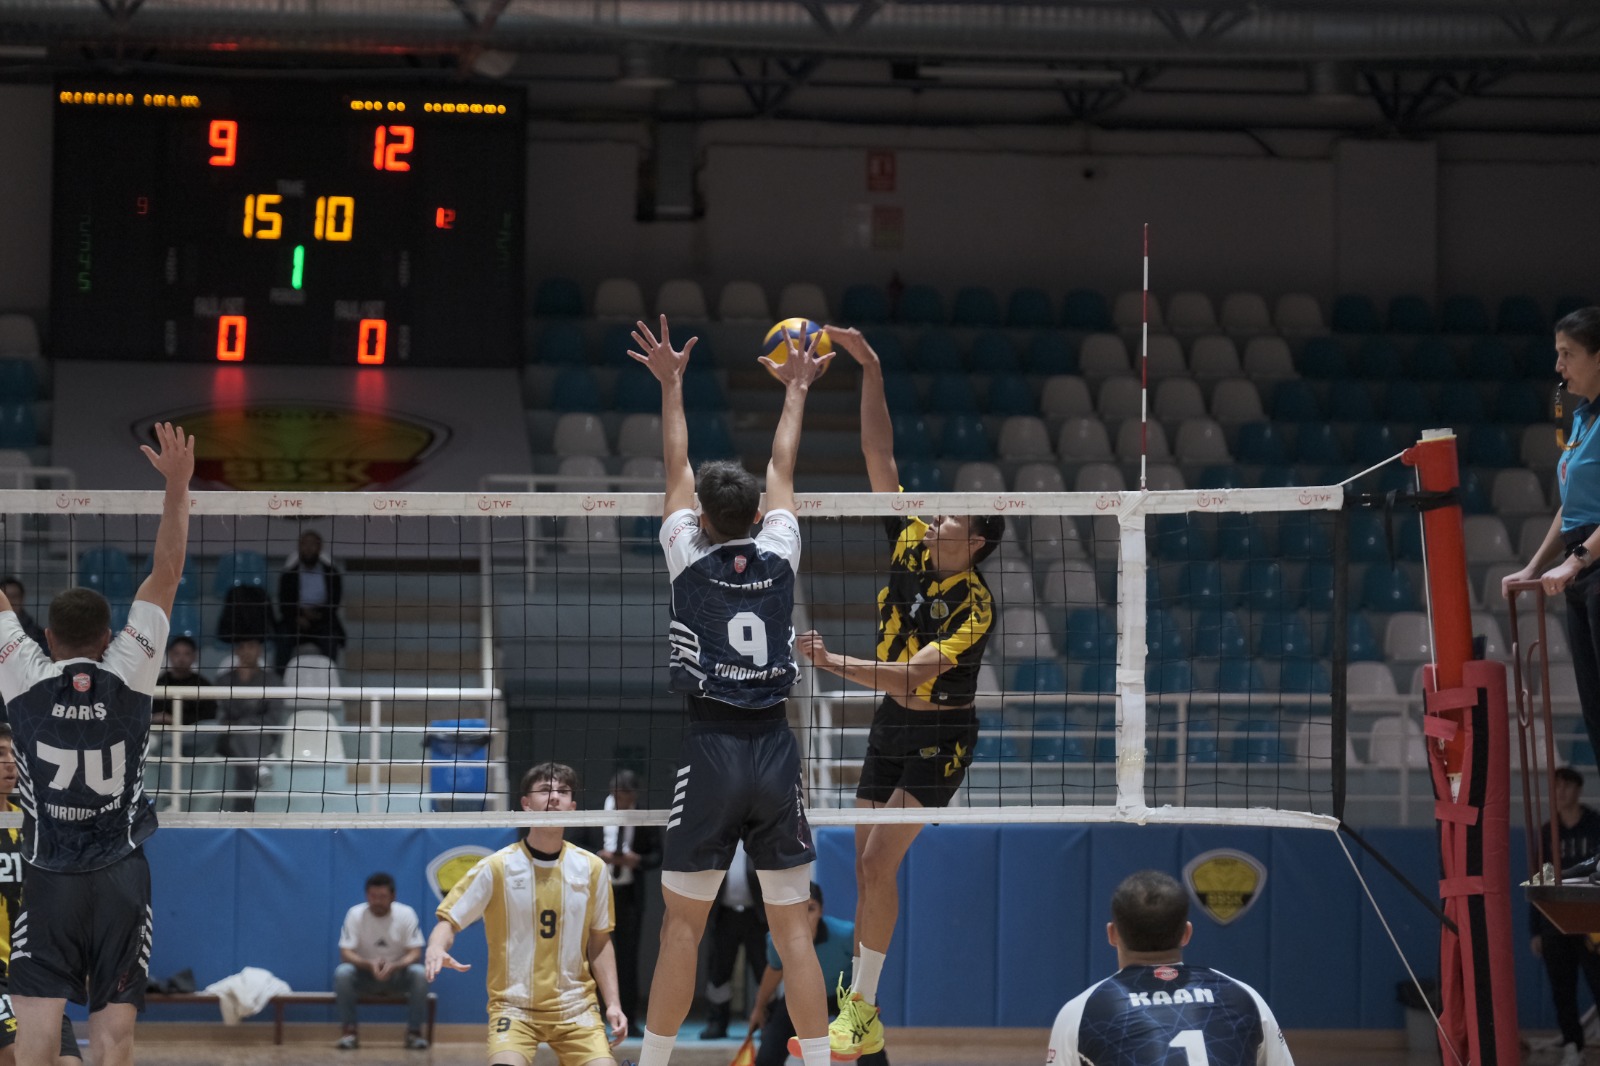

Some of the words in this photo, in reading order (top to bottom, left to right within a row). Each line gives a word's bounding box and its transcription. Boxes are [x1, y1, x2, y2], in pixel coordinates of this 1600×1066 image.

[208, 120, 238, 166] 9
[373, 126, 414, 171] 12
[137, 197, 148, 214] 9
[243, 194, 282, 239] 15
[314, 196, 354, 241] 10
[292, 245, 304, 289] 1
[217, 316, 247, 361] 0
[358, 319, 387, 364] 0
[283, 499, 303, 508] TVF
[389, 500, 407, 508] TVF
[493, 500, 512, 509] TVF
[597, 500, 616, 509] TVF
[803, 500, 822, 509] TVF
[906, 500, 925, 509] TVF
[1212, 497, 1226, 505] TV
[727, 611, 768, 667] 9
[51, 702, 108, 721] BARIŞ
[0, 852, 22, 883] 21
[540, 910, 557, 939] 9
[1129, 988, 1215, 1006] KAAN
[496, 1016, 511, 1033] 9
[1169, 1030, 1210, 1066] 1
